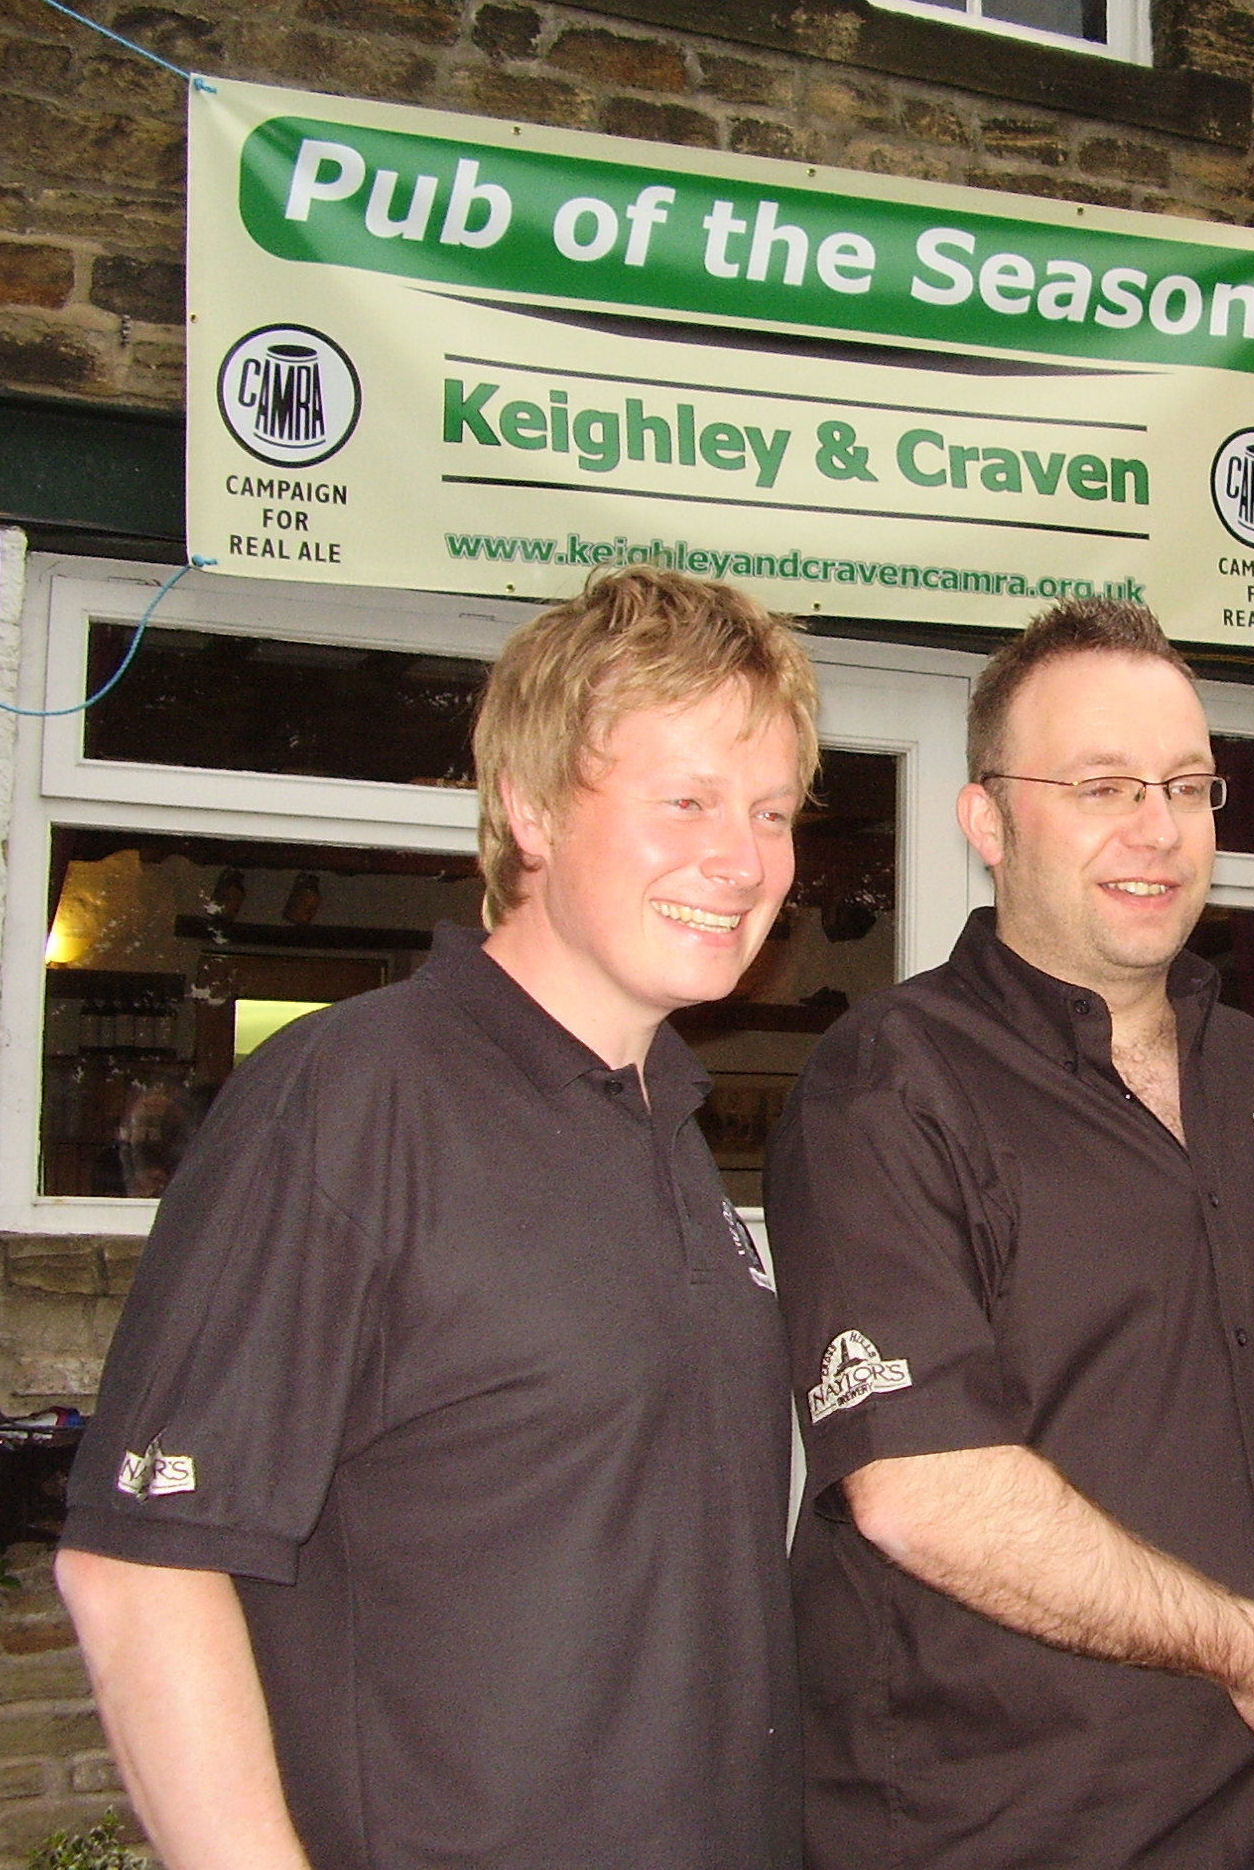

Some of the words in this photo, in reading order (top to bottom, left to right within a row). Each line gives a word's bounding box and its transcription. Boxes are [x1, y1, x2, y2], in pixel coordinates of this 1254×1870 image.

[284, 138, 512, 249] Pub
[553, 186, 676, 266] of
[702, 199, 876, 295] the
[238, 358, 326, 441] CAMRA
[442, 378, 792, 488] Keighley
[815, 420, 879, 484] &
[896, 428, 1150, 505] Craven
[226, 475, 347, 505] CAMPAIGN
[262, 508, 309, 532] FOR
[229, 534, 291, 560] REAL
[298, 541, 342, 564] ALE
